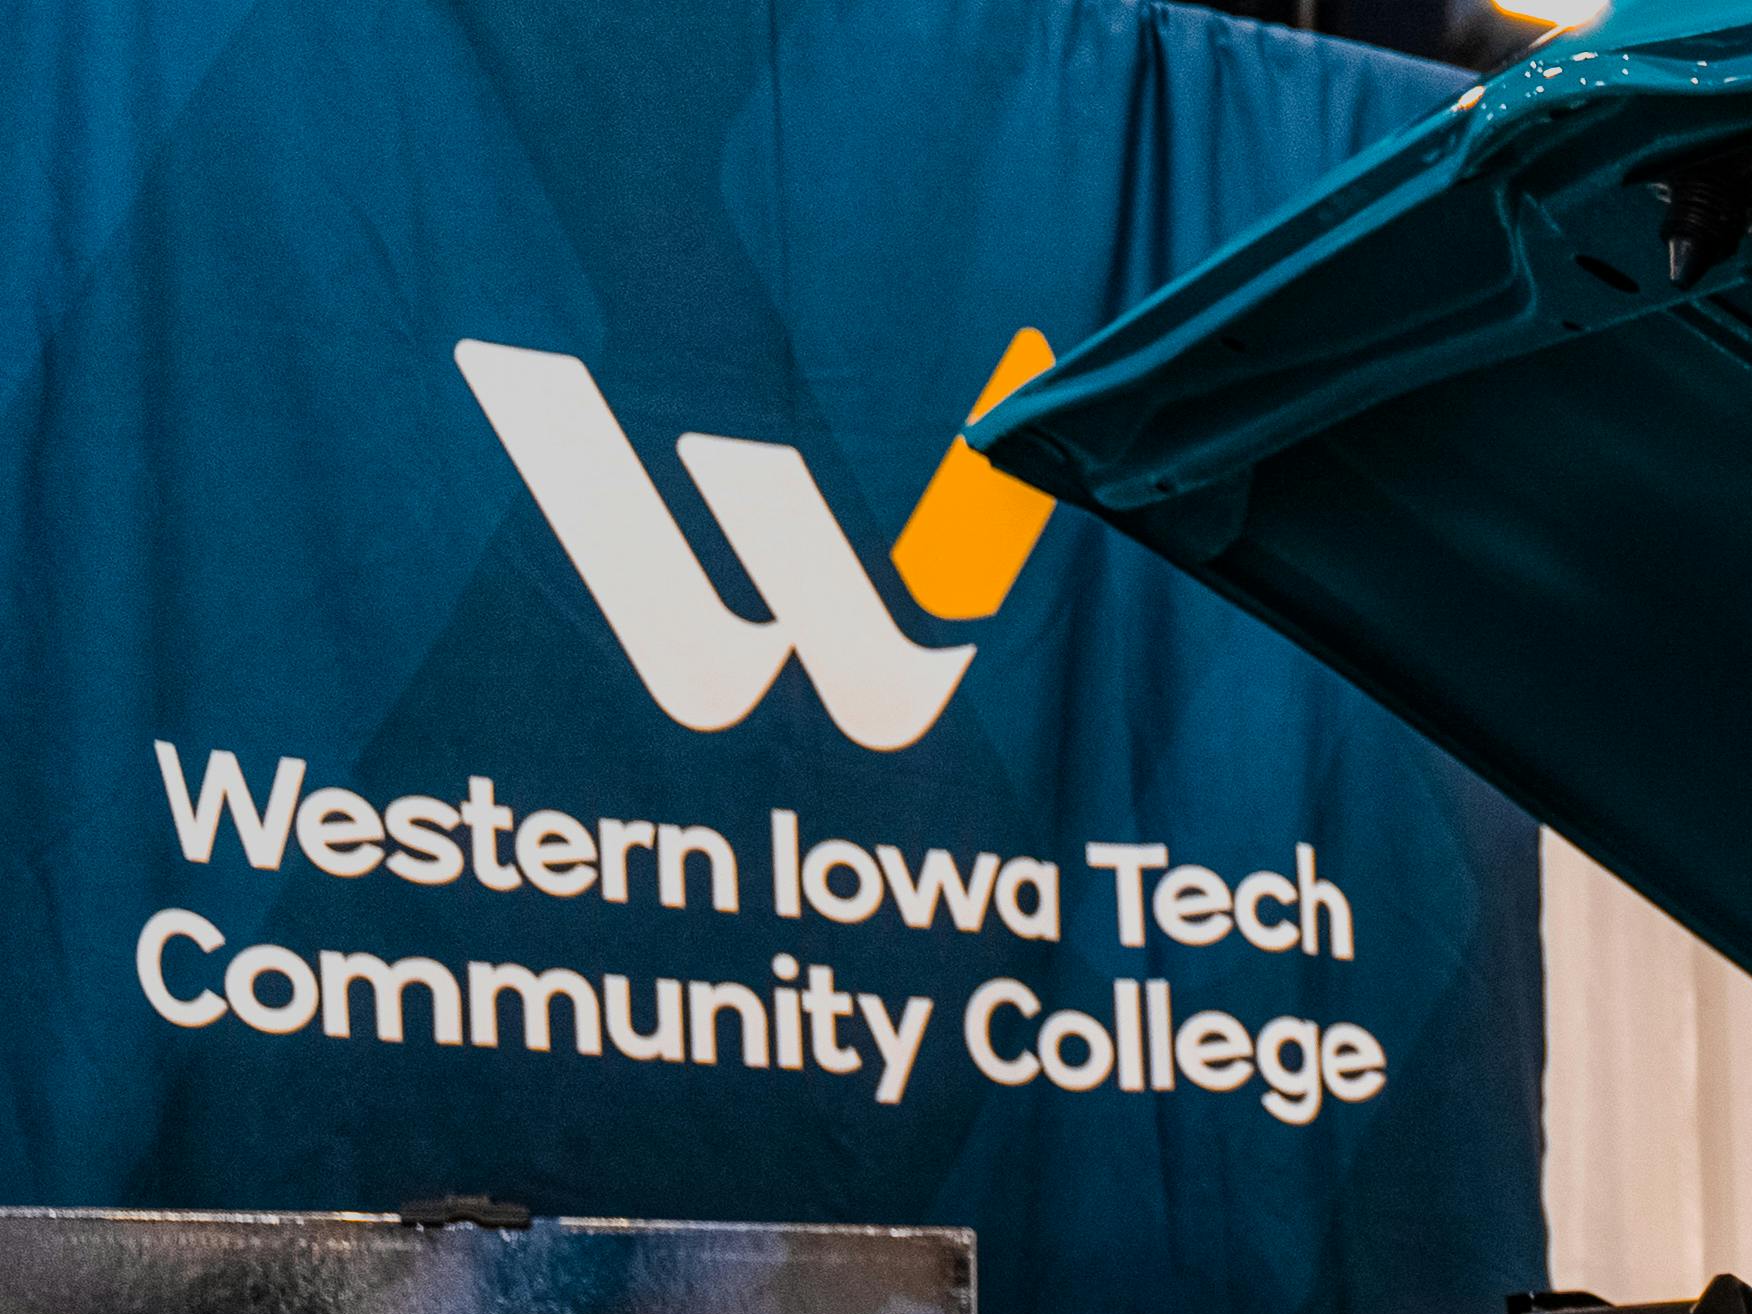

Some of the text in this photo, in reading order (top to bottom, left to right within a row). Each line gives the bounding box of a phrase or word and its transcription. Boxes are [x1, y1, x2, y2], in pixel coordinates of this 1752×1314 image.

[153, 739, 1356, 960] Western Iowa Tech
[134, 906, 1389, 1125] Community College
